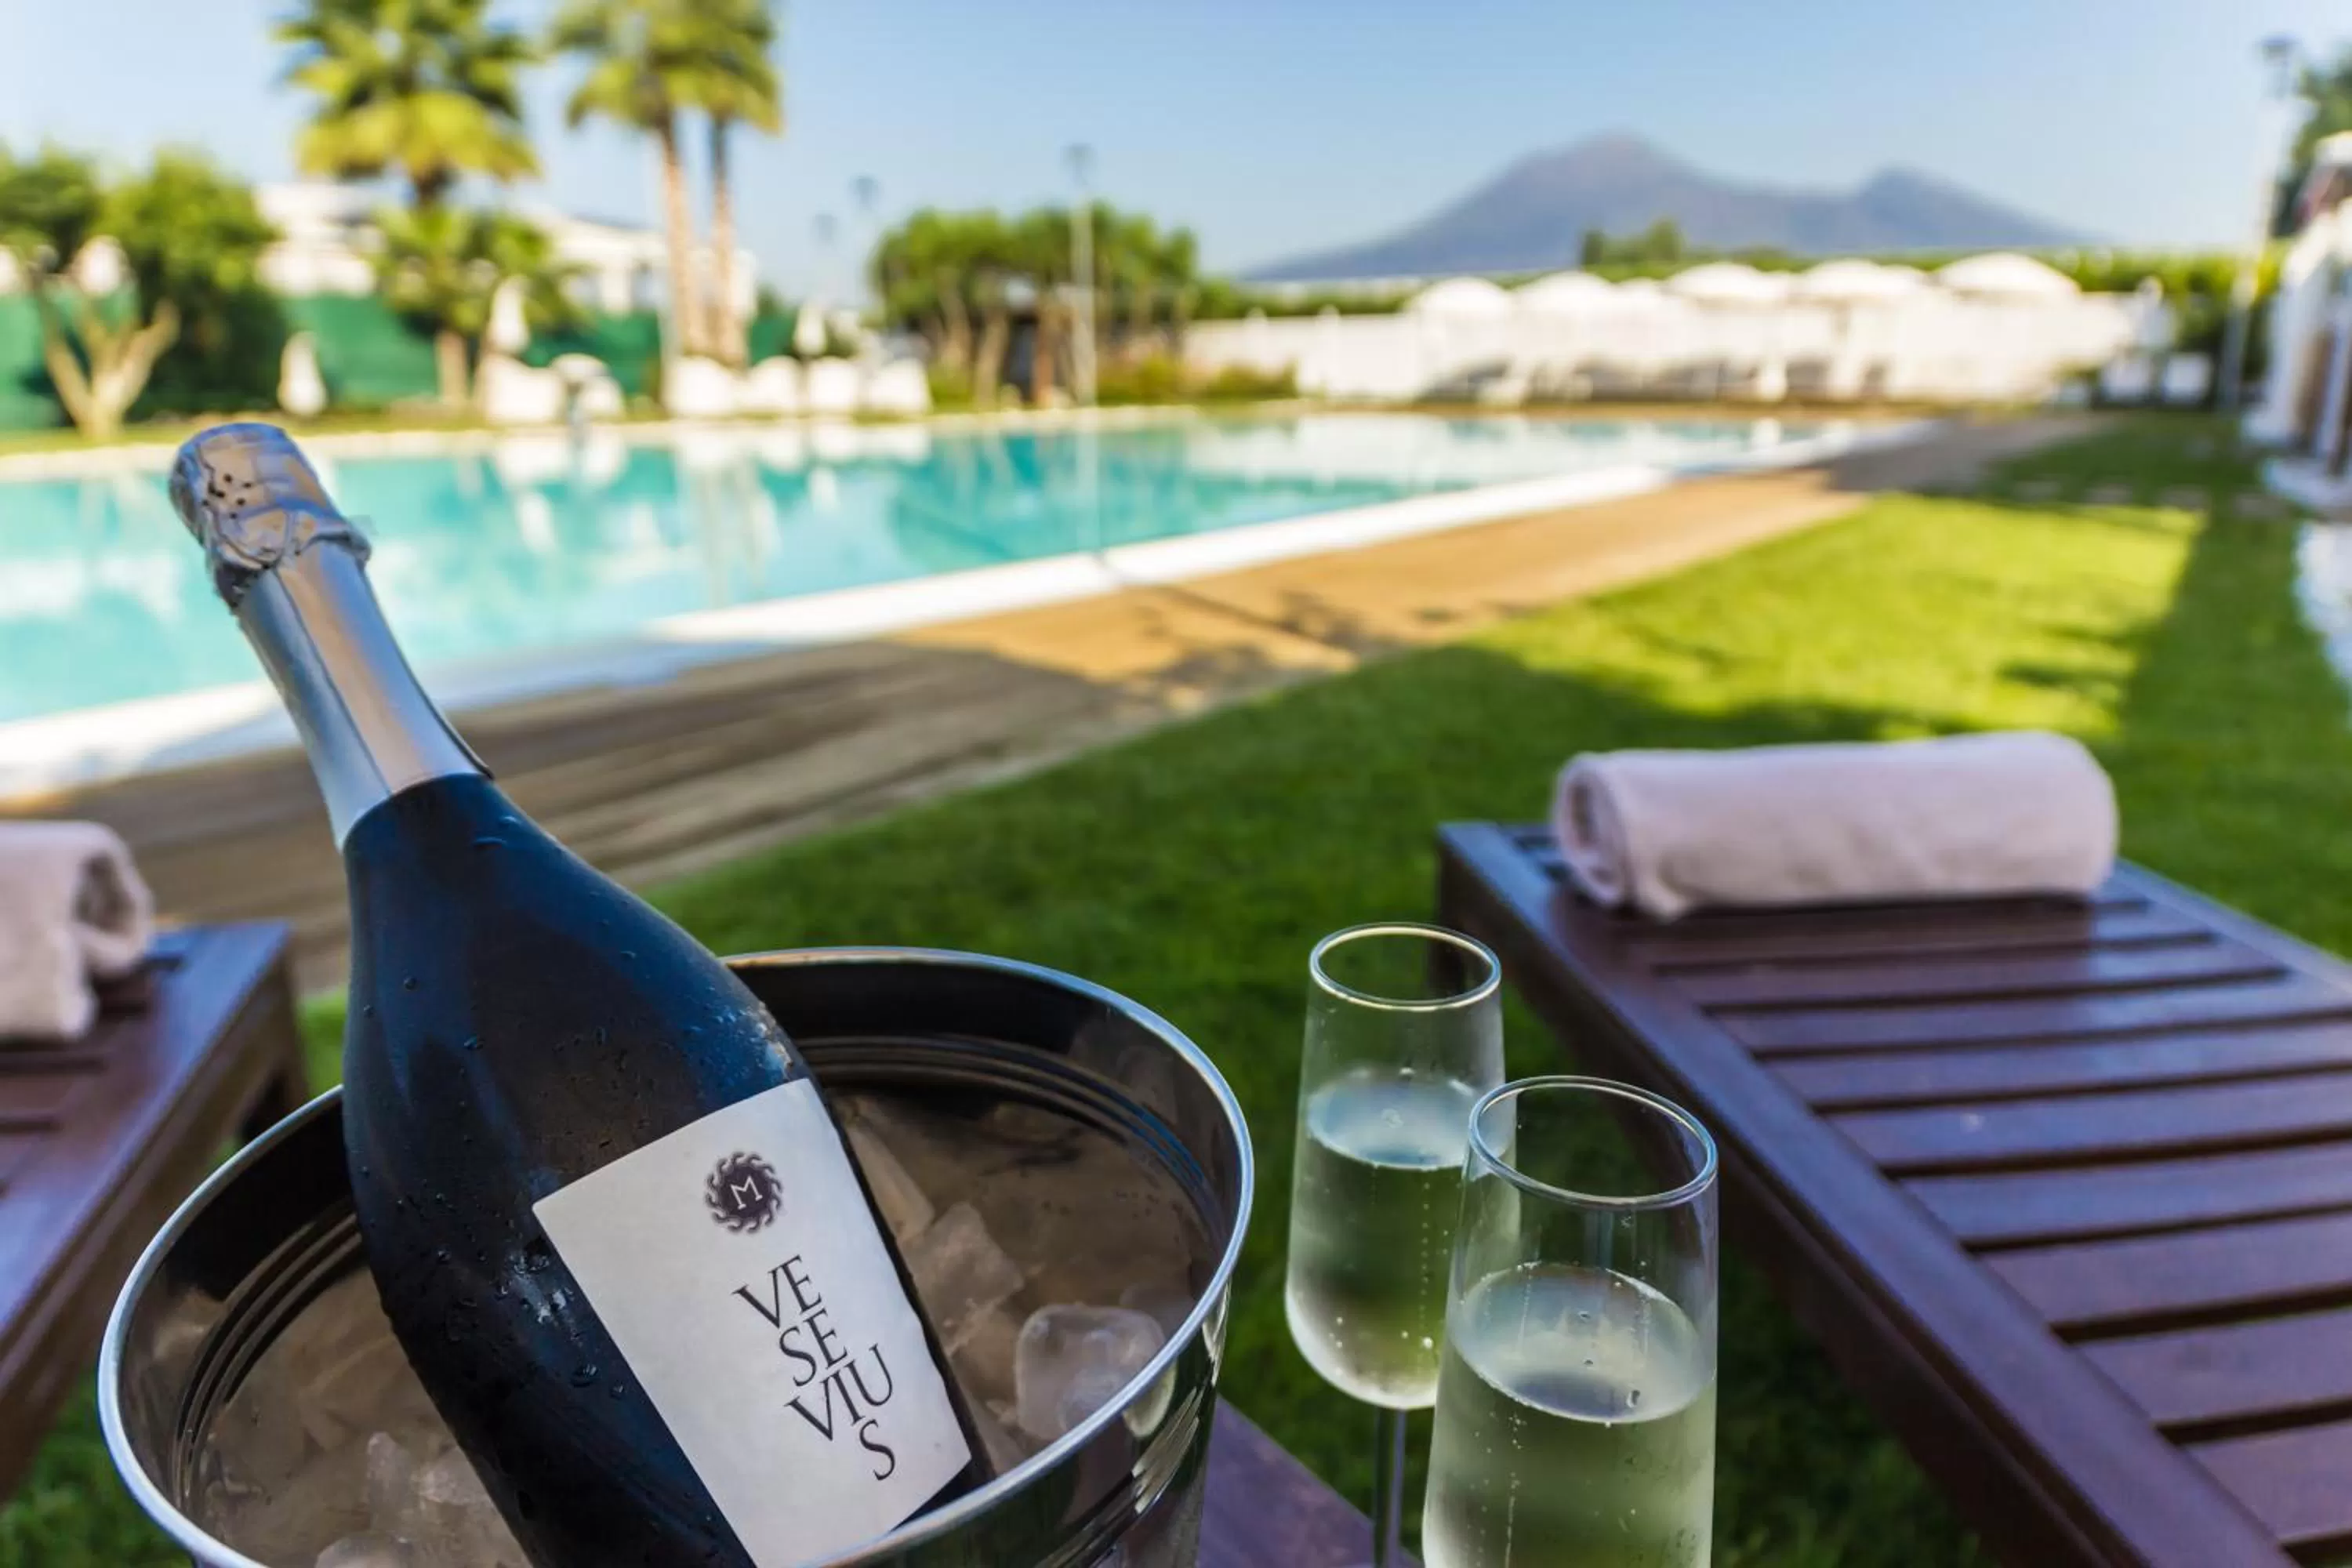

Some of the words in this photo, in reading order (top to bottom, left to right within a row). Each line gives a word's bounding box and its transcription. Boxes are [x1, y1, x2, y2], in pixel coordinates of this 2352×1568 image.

[730, 1174, 764, 1210] M
[731, 1254, 822, 1329] VE
[779, 1308, 848, 1387] SE
[859, 1419, 896, 1480] S
